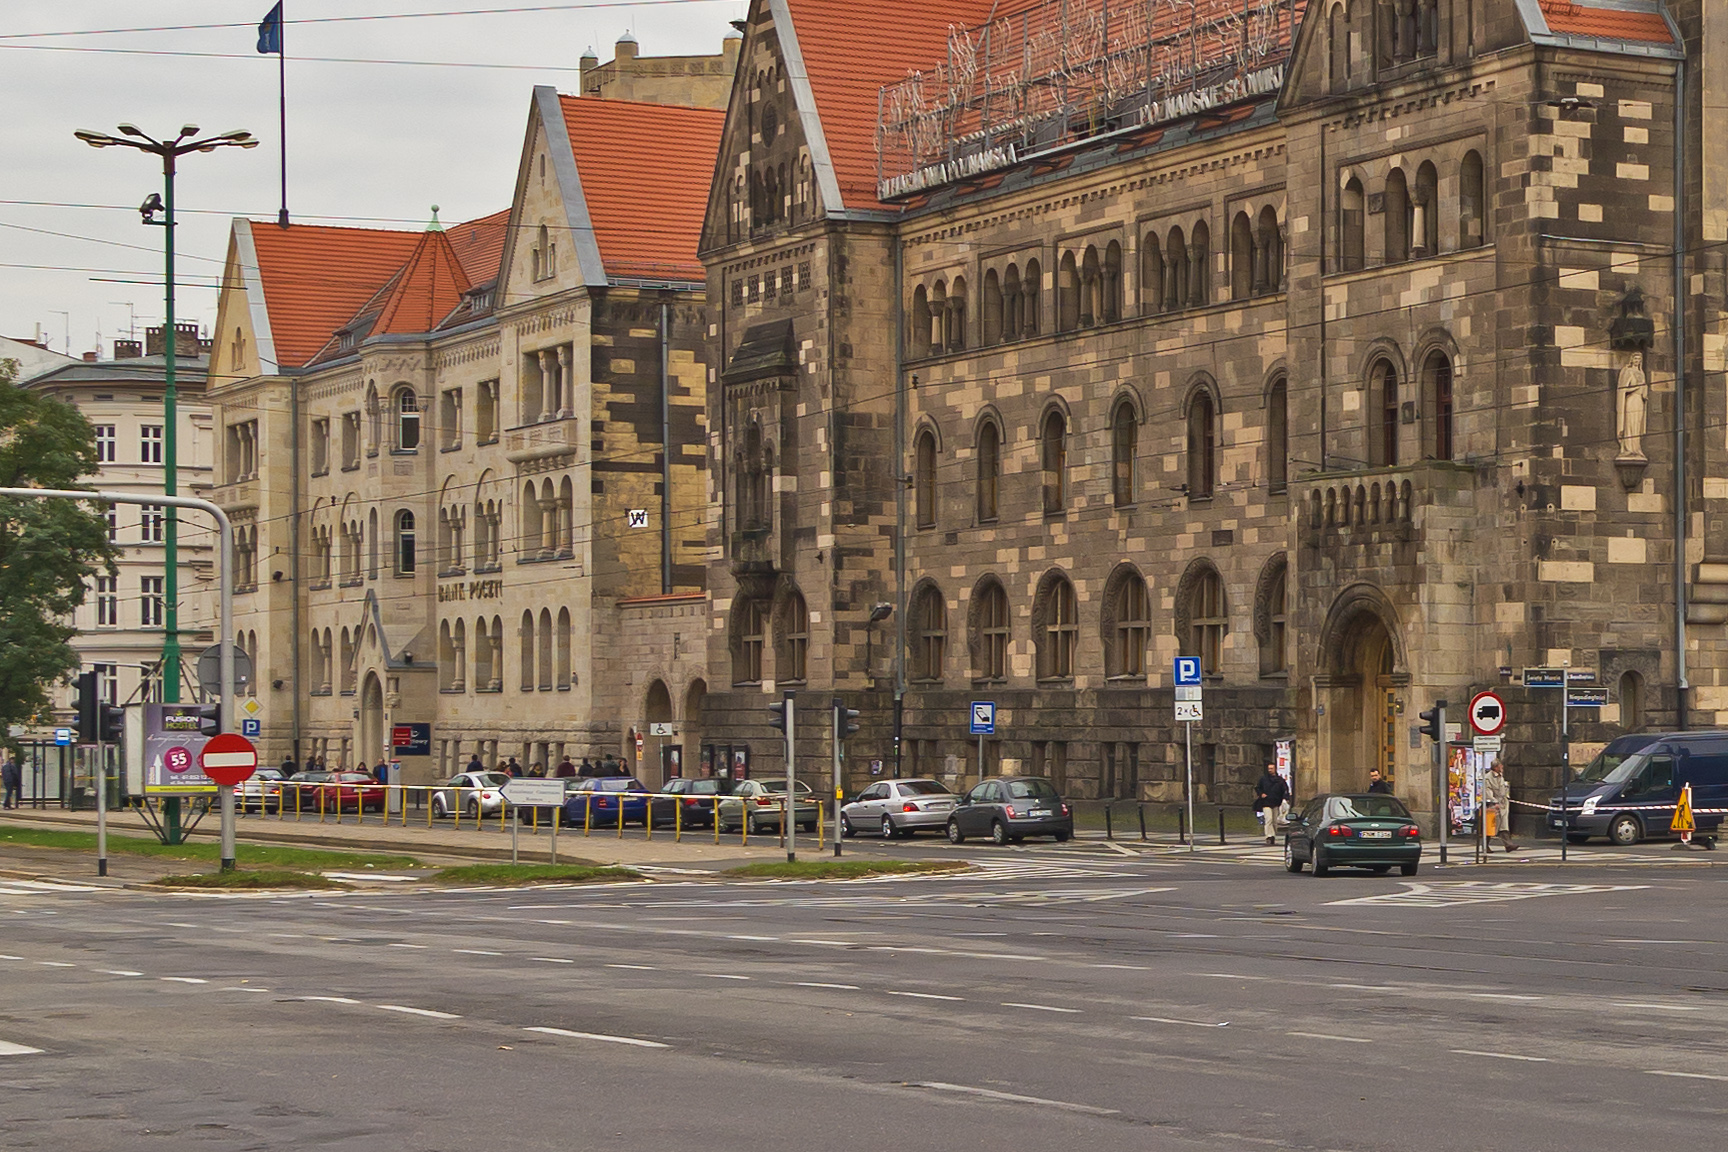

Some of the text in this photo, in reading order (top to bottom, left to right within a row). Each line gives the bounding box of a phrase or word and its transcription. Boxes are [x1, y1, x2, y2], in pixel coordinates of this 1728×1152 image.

[438, 582, 466, 602] BANK
[1180, 660, 1195, 681] P
[165, 715, 200, 723] FUSION
[246, 721, 257, 733] P
[171, 752, 188, 766] 55
